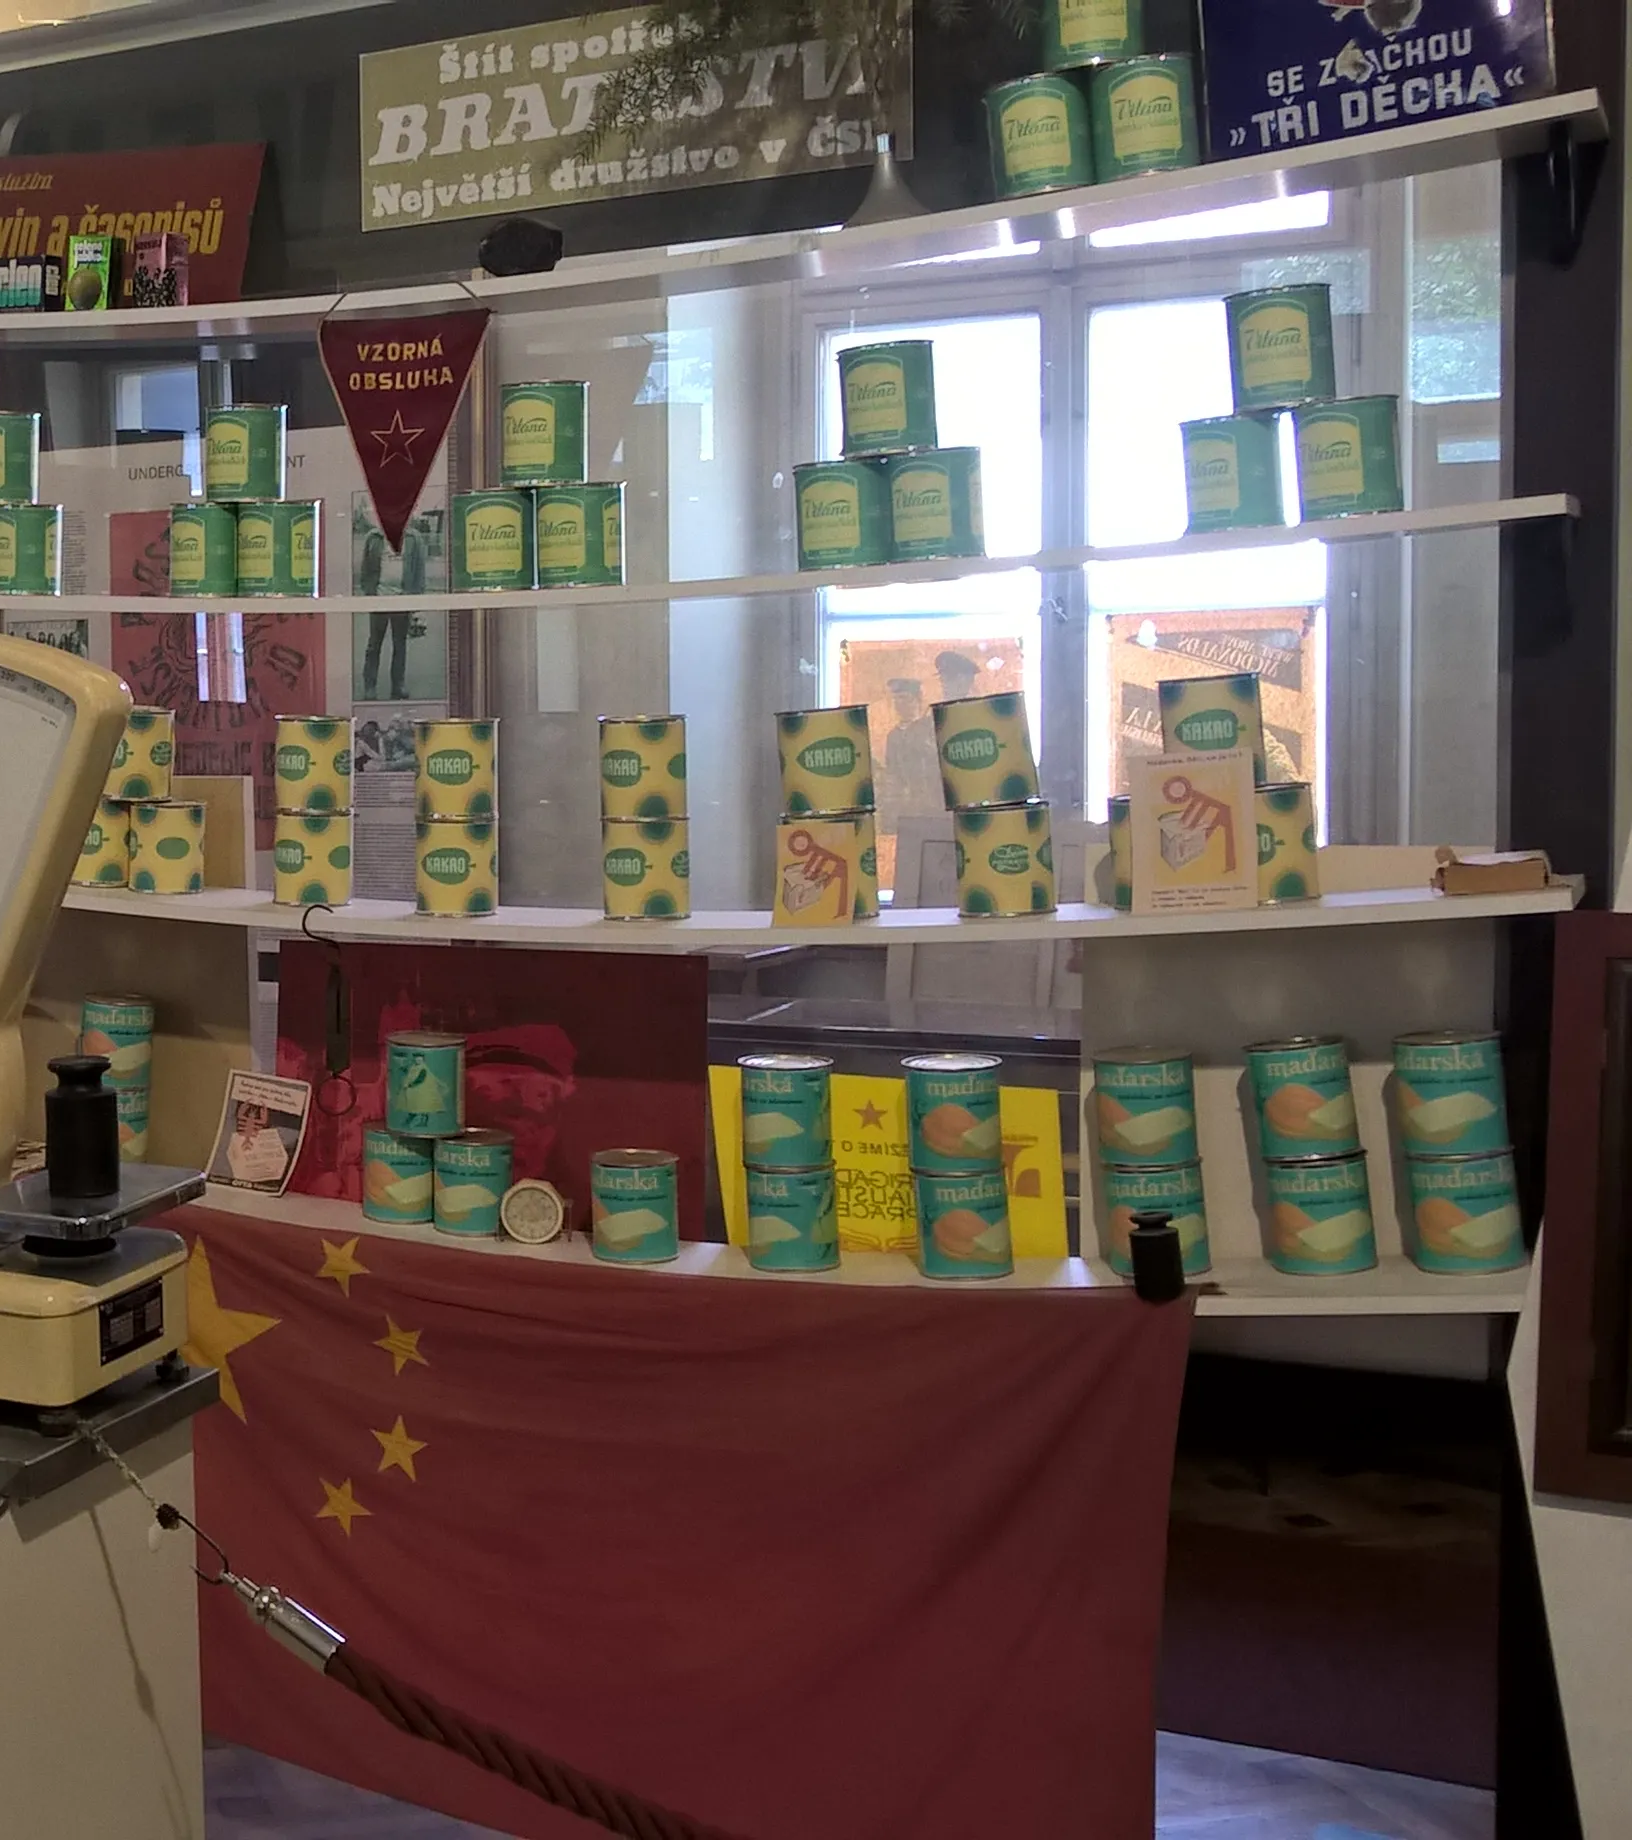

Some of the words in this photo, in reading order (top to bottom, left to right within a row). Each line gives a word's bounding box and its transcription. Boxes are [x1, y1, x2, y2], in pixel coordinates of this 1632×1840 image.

[1267, 65, 1305, 97] SE
[549, 144, 741, 192] družstvo
[758, 138, 787, 164] v
[45, 214, 69, 257] a
[357, 333, 445, 362] VZORNÁ
[348, 366, 455, 391] OBSLUHA
[1181, 719, 1234, 742] KAKAO
[803, 746, 852, 768] KAKAO
[946, 736, 996, 760] KAKAO
[428, 757, 471, 775] KAKAO
[425, 856, 467, 874] KAKAO
